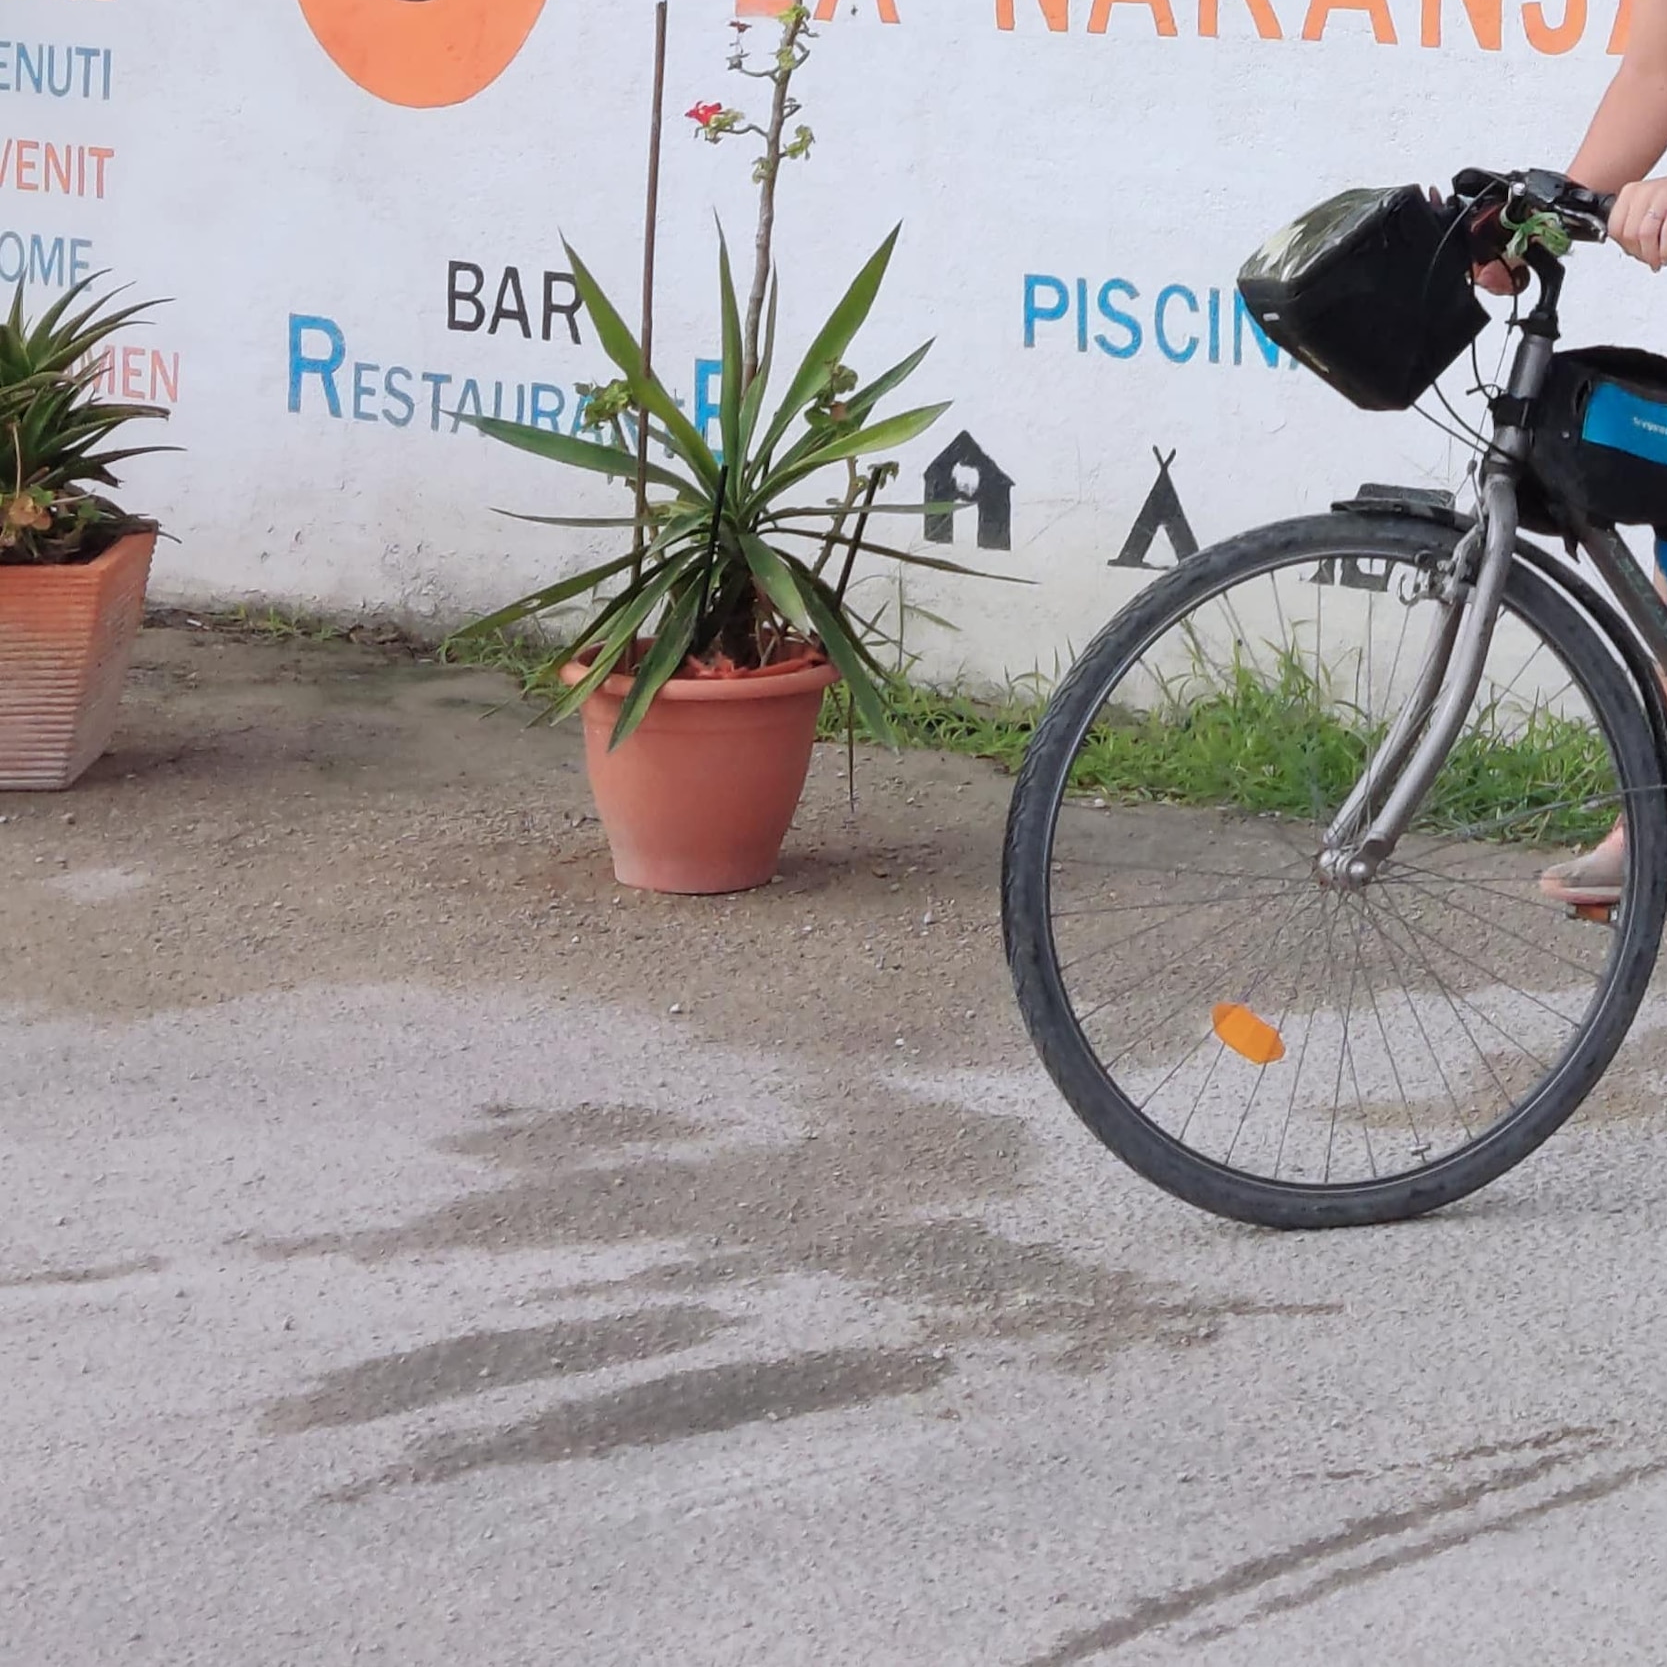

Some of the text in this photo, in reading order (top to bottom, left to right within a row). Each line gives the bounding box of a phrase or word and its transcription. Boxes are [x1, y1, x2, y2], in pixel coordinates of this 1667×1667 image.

[447, 260, 584, 345] BAR
[1023, 273, 1299, 371] PISCIN
[288, 312, 724, 465] RESTAURAE
